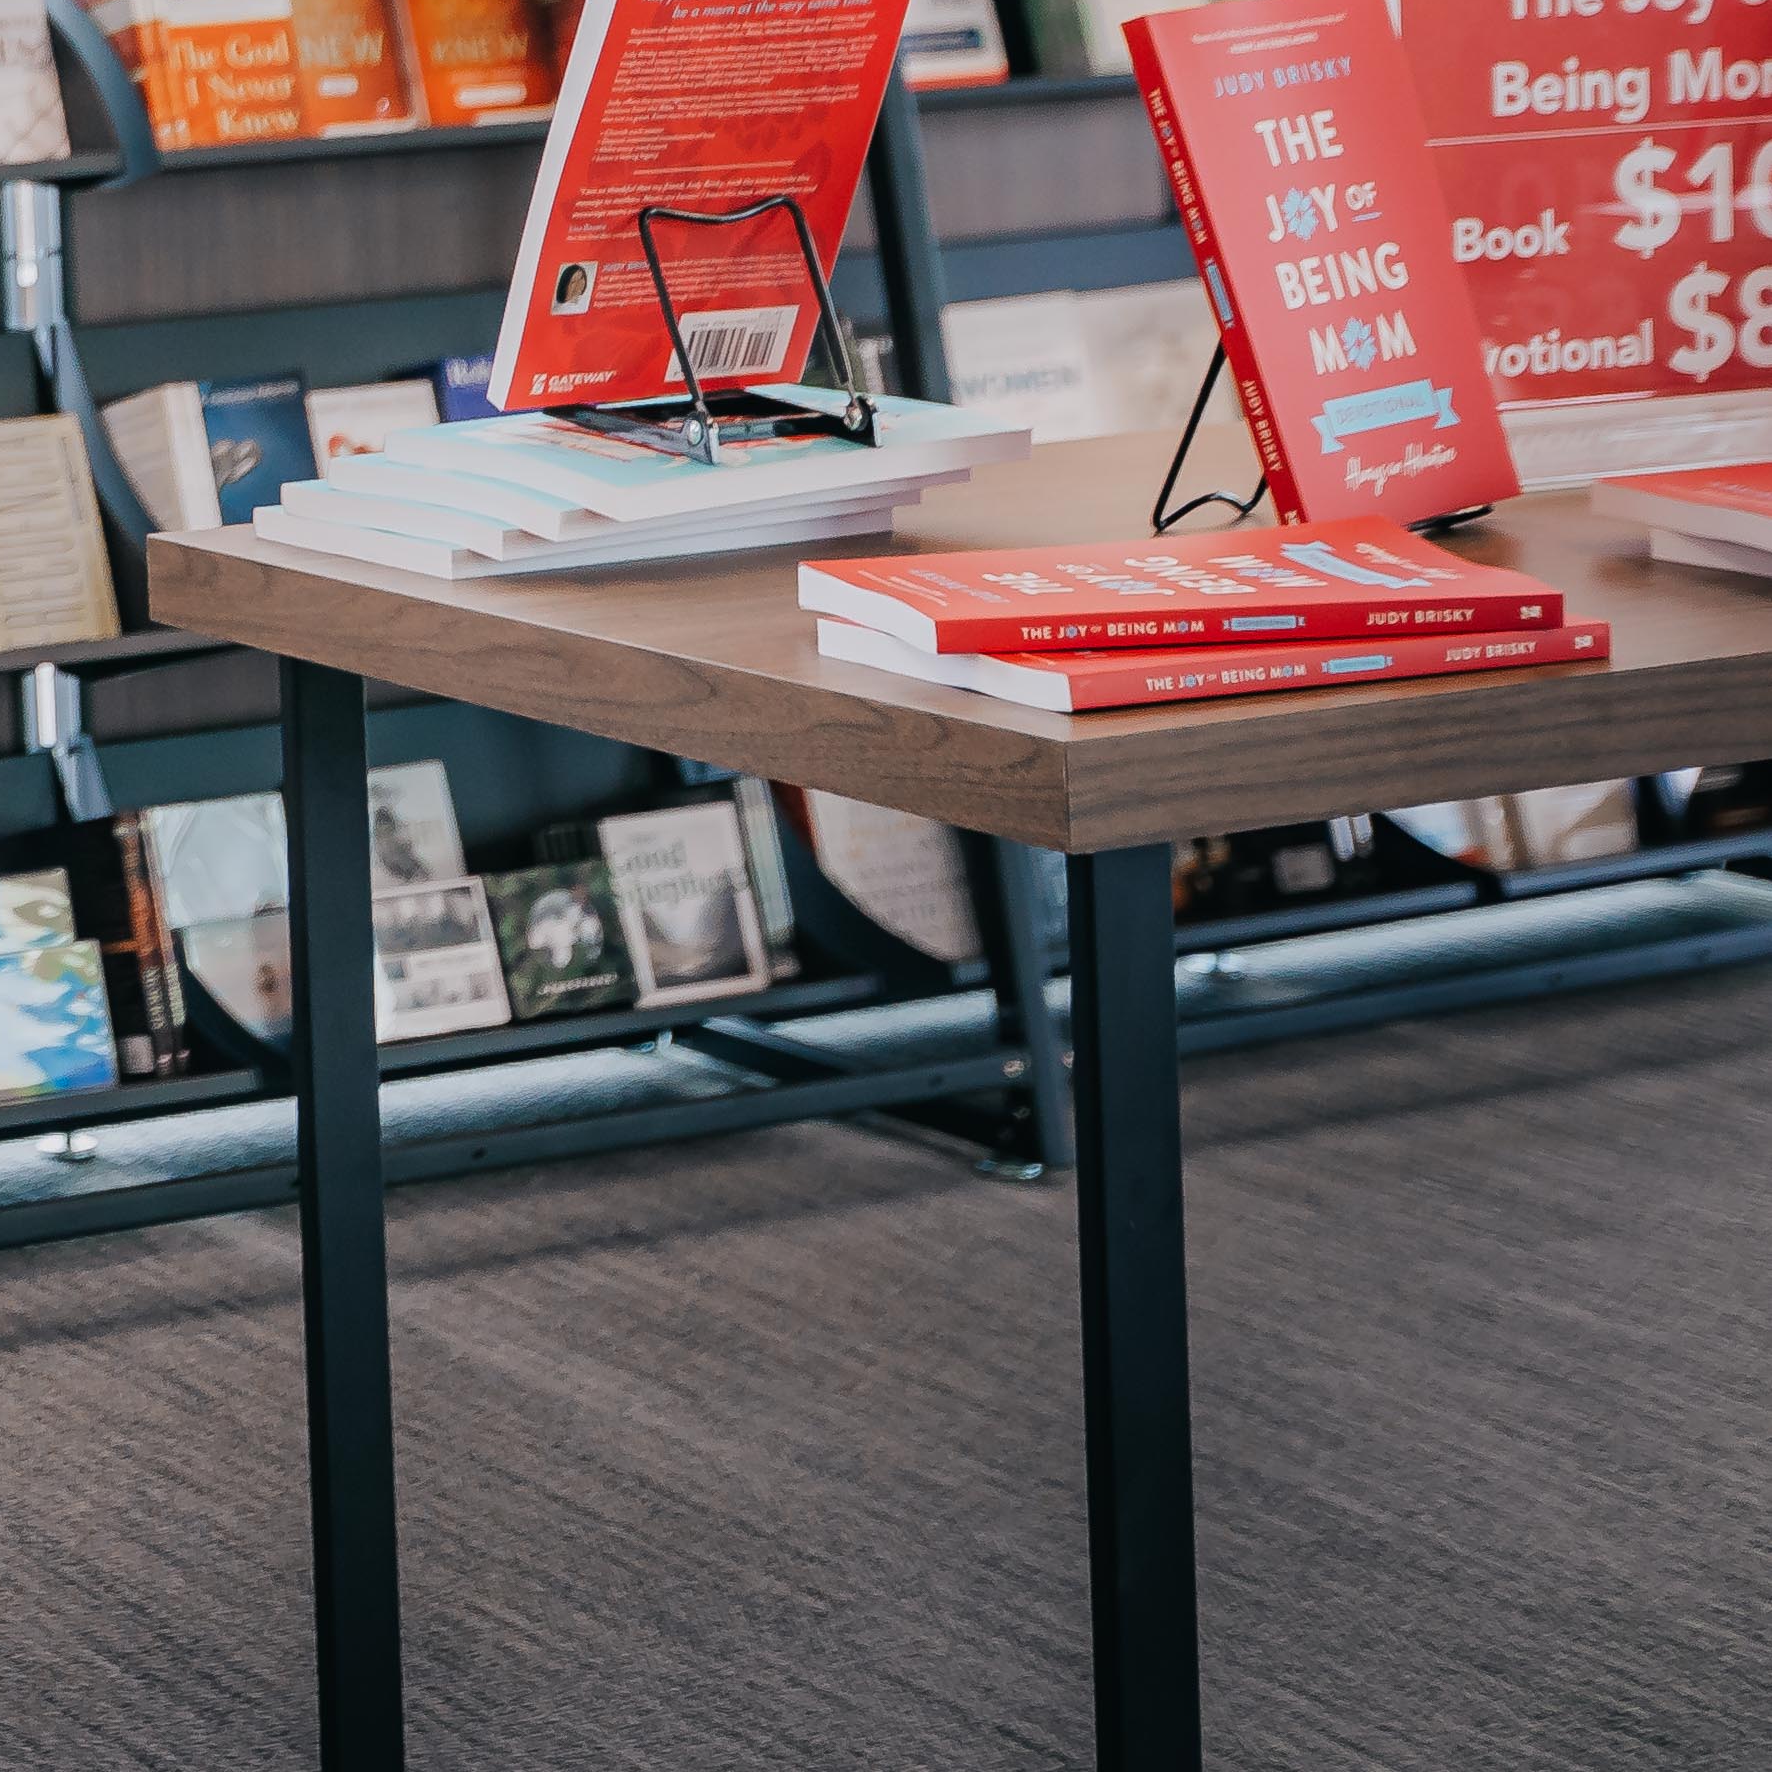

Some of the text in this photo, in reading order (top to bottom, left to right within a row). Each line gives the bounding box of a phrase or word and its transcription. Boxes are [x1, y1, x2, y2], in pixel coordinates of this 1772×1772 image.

[691, 7, 699, 17] a
[755, 0, 776, 15] the
[778, 1, 805, 14] very
[1214, 55, 1352, 99] JUDY BRISKY
[1490, 54, 1651, 124] Being
[1254, 108, 1345, 168] THE
[1344, 180, 1378, 212] OF
[1451, 209, 1572, 265] Book
[1147, 87, 1167, 119] THE
[1170, 160, 1195, 206] BEING
[1242, 379, 1264, 416] JUDY
[1255, 416, 1286, 473] BRISKY
[1274, 242, 1411, 312] BEING
[548, 371, 616, 387] GATEWAY
[1021, 626, 1052, 640] THE
[1107, 620, 1157, 637] BEING
[1366, 610, 1411, 626] JUDY
[1414, 608, 1476, 624] BRISKY
[1146, 677, 1174, 692] THE
[1221, 667, 1266, 684] BEING
[1444, 647, 1483, 662] JUDY
[1485, 641, 1537, 659] BRISKY
